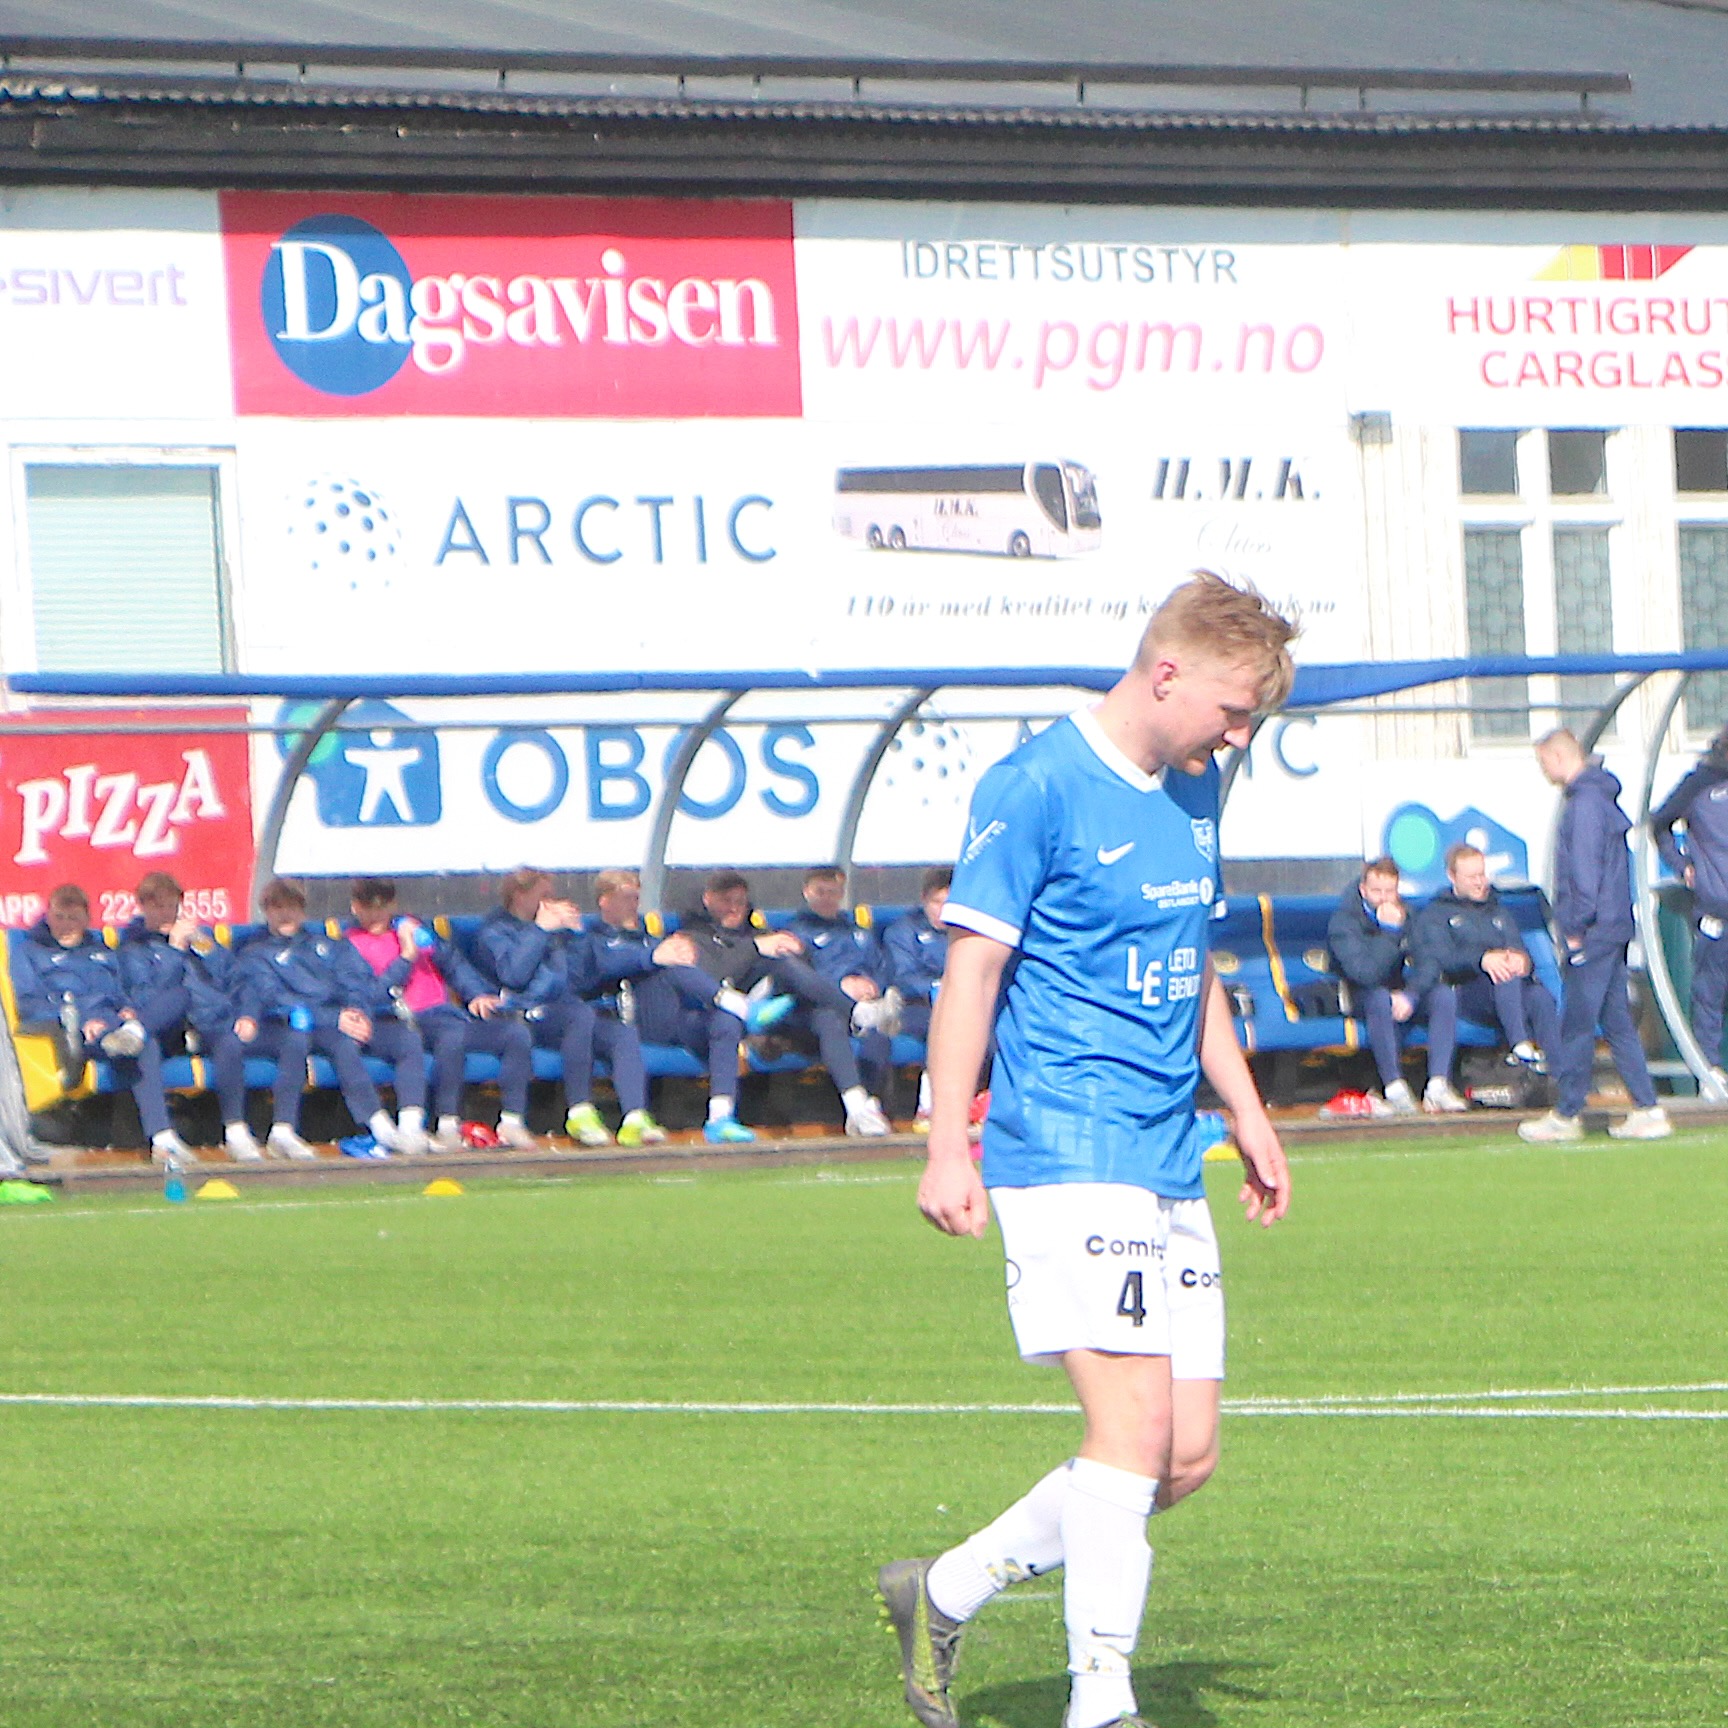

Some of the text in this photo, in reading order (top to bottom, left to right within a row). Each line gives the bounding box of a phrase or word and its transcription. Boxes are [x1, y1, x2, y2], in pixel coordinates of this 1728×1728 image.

[901, 240, 1240, 284] IDRETTSUTSTYR
[270, 240, 779, 373] Dagsavisen
[819, 313, 1326, 392] www.pgm.no
[434, 492, 779, 566] ARCTIC
[938, 594, 993, 617] med
[13, 750, 224, 864] PIZZA
[480, 722, 821, 824] OBOS
[1116, 1270, 1147, 1328] 4
